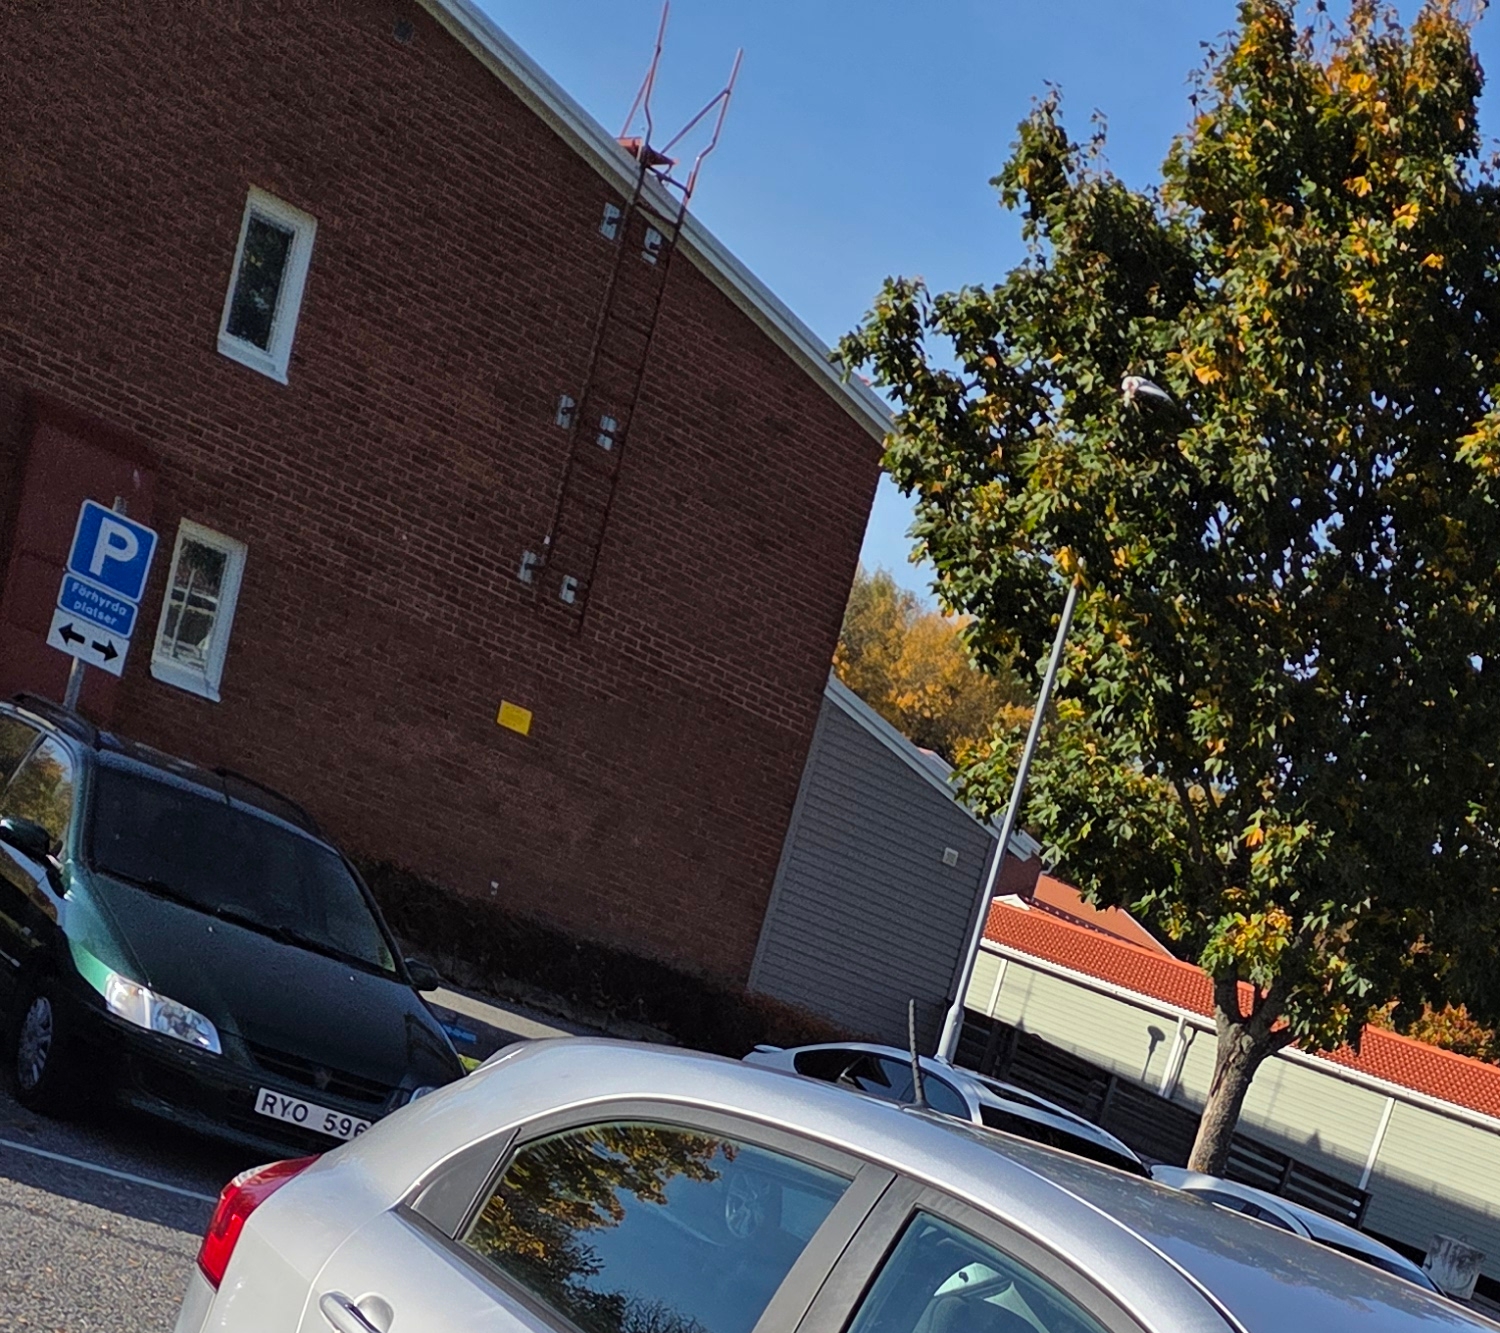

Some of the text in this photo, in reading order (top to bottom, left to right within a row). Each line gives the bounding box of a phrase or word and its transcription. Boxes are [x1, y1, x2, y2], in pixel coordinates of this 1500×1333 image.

[89, 517, 139, 576] P
[71, 582, 128, 616] Förhyrda
[73, 602, 117, 625] platser
[261, 1092, 308, 1123] RYO
